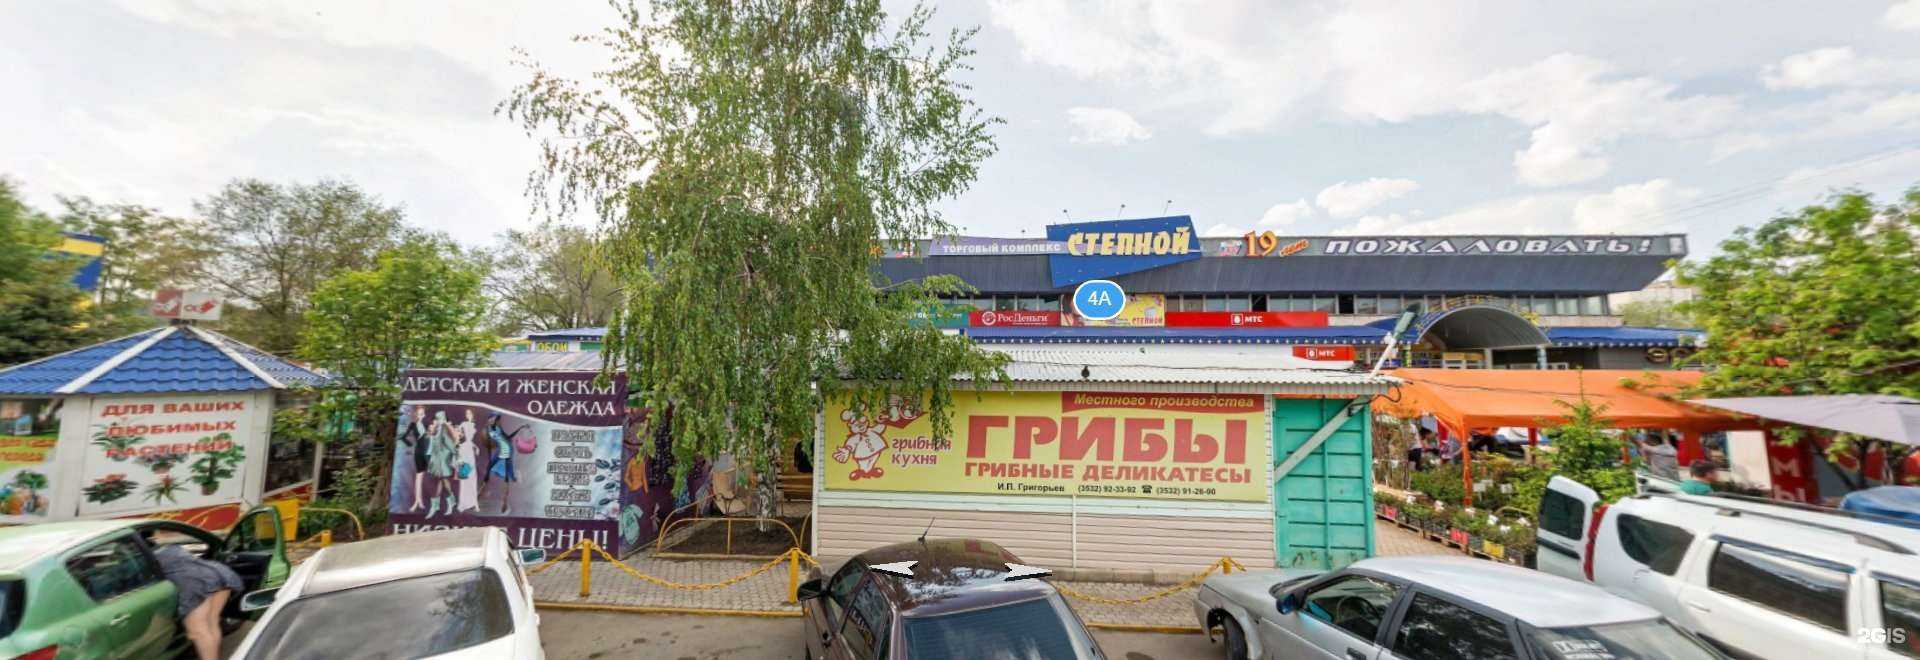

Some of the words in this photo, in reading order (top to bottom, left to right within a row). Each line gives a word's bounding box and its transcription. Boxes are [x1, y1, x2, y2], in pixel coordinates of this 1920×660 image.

[943, 243, 999, 253] ТОРГОВЫЙ
[1001, 243, 1061, 253] КОМПЛЕКС
[1067, 227, 1191, 256] СТЕПНОЙ
[1244, 230, 1278, 257] 19
[1324, 238, 1652, 254] ПОЖАЛОВАТЬ!
[403, 376, 490, 394] ДЕТСКАЯ
[497, 379, 510, 394] И
[516, 379, 616, 395] ЖЕНСКАЯ
[102, 403, 155, 417] ДЛЯ
[163, 401, 245, 414] ВАШИХ
[527, 400, 616, 416] ОДЕЖДА
[1074, 393, 1146, 406] Местного
[1150, 396, 1255, 409] производства
[966, 415, 1248, 465] ГРИБЫ
[891, 454, 937, 468] кухня
[965, 462, 1074, 480] ГРИБНЫЕ
[1082, 465, 1252, 483] ДЕЛИКАТЕСЫ
[1018, 482, 1065, 493] Григорьев
